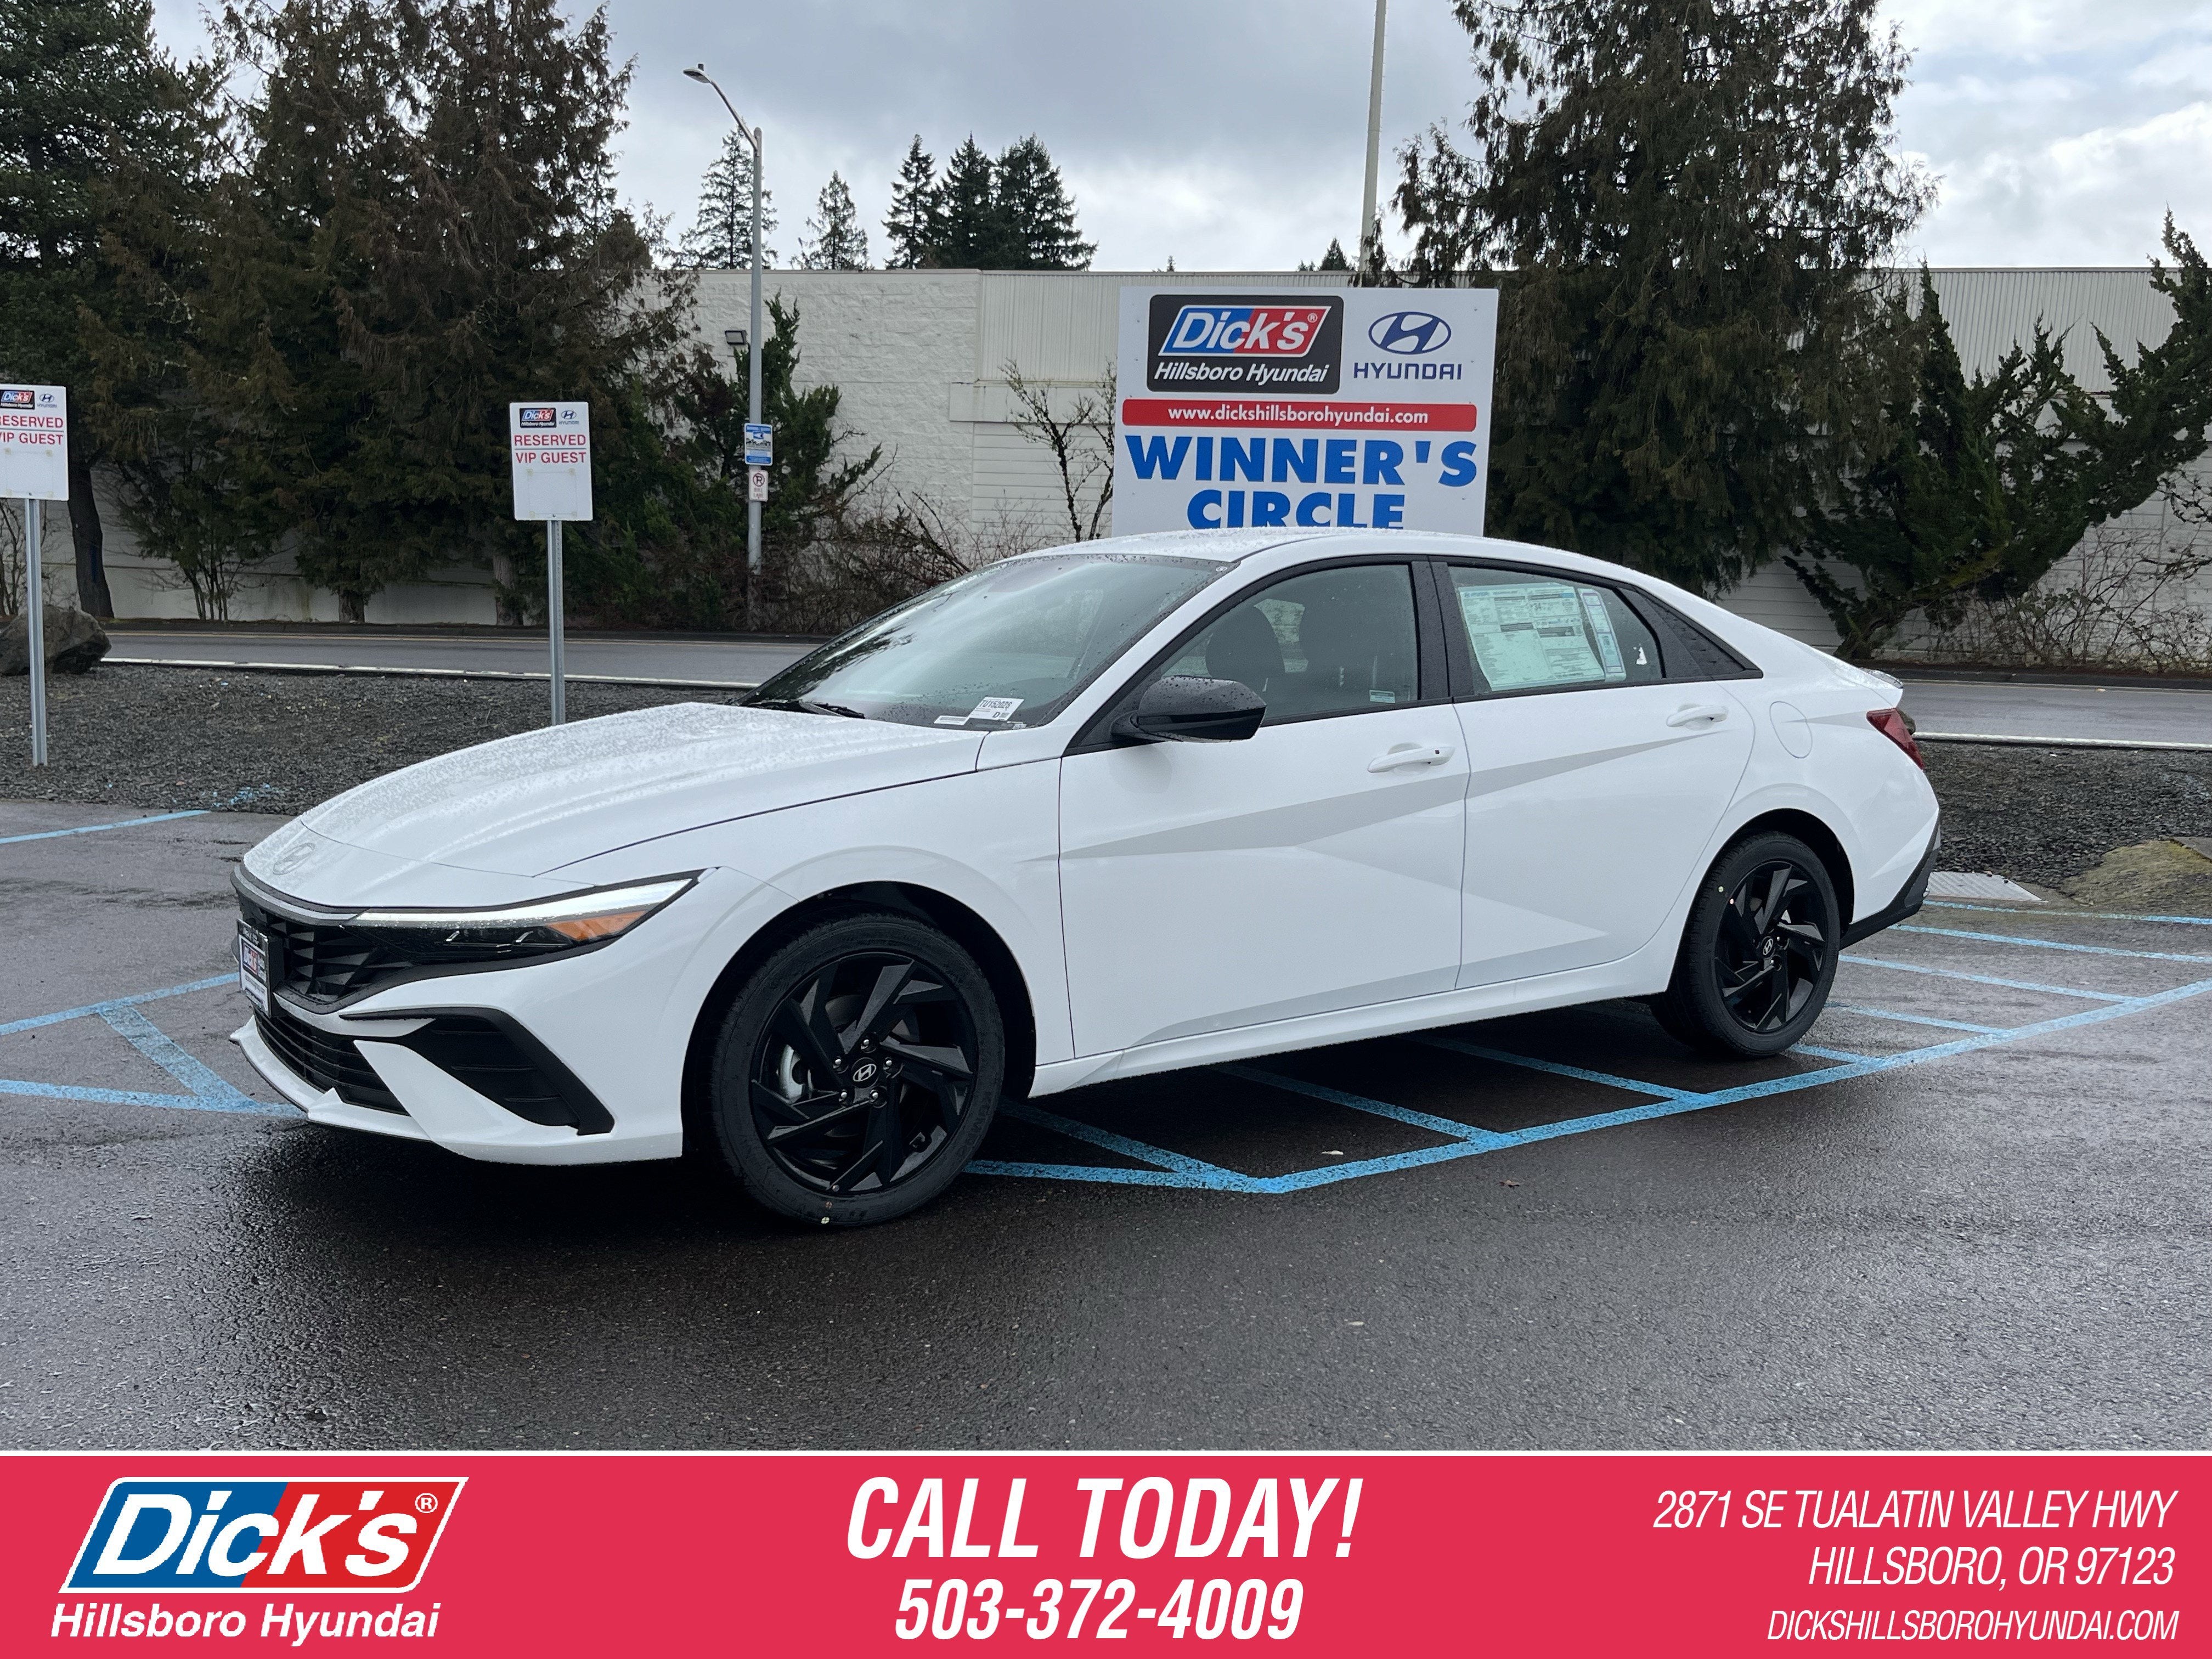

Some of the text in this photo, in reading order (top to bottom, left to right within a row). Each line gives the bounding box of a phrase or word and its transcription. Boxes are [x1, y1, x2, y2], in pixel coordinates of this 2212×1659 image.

[1172, 311, 1309, 351] Dick's
[1154, 362, 1330, 386] Hillsboro Hyundai
[1353, 362, 1462, 381] HYUNDAI
[0, 415, 64, 428] ESERVED
[1167, 404, 1429, 427] www.dickshillsborohyundai.com
[0, 432, 64, 445] IP GUEST
[514, 435, 586, 446] RESERVED
[515, 452, 586, 464] VIP GUEST
[1124, 434, 1478, 487] WINNER'S
[1186, 488, 1406, 531] CIRCLE
